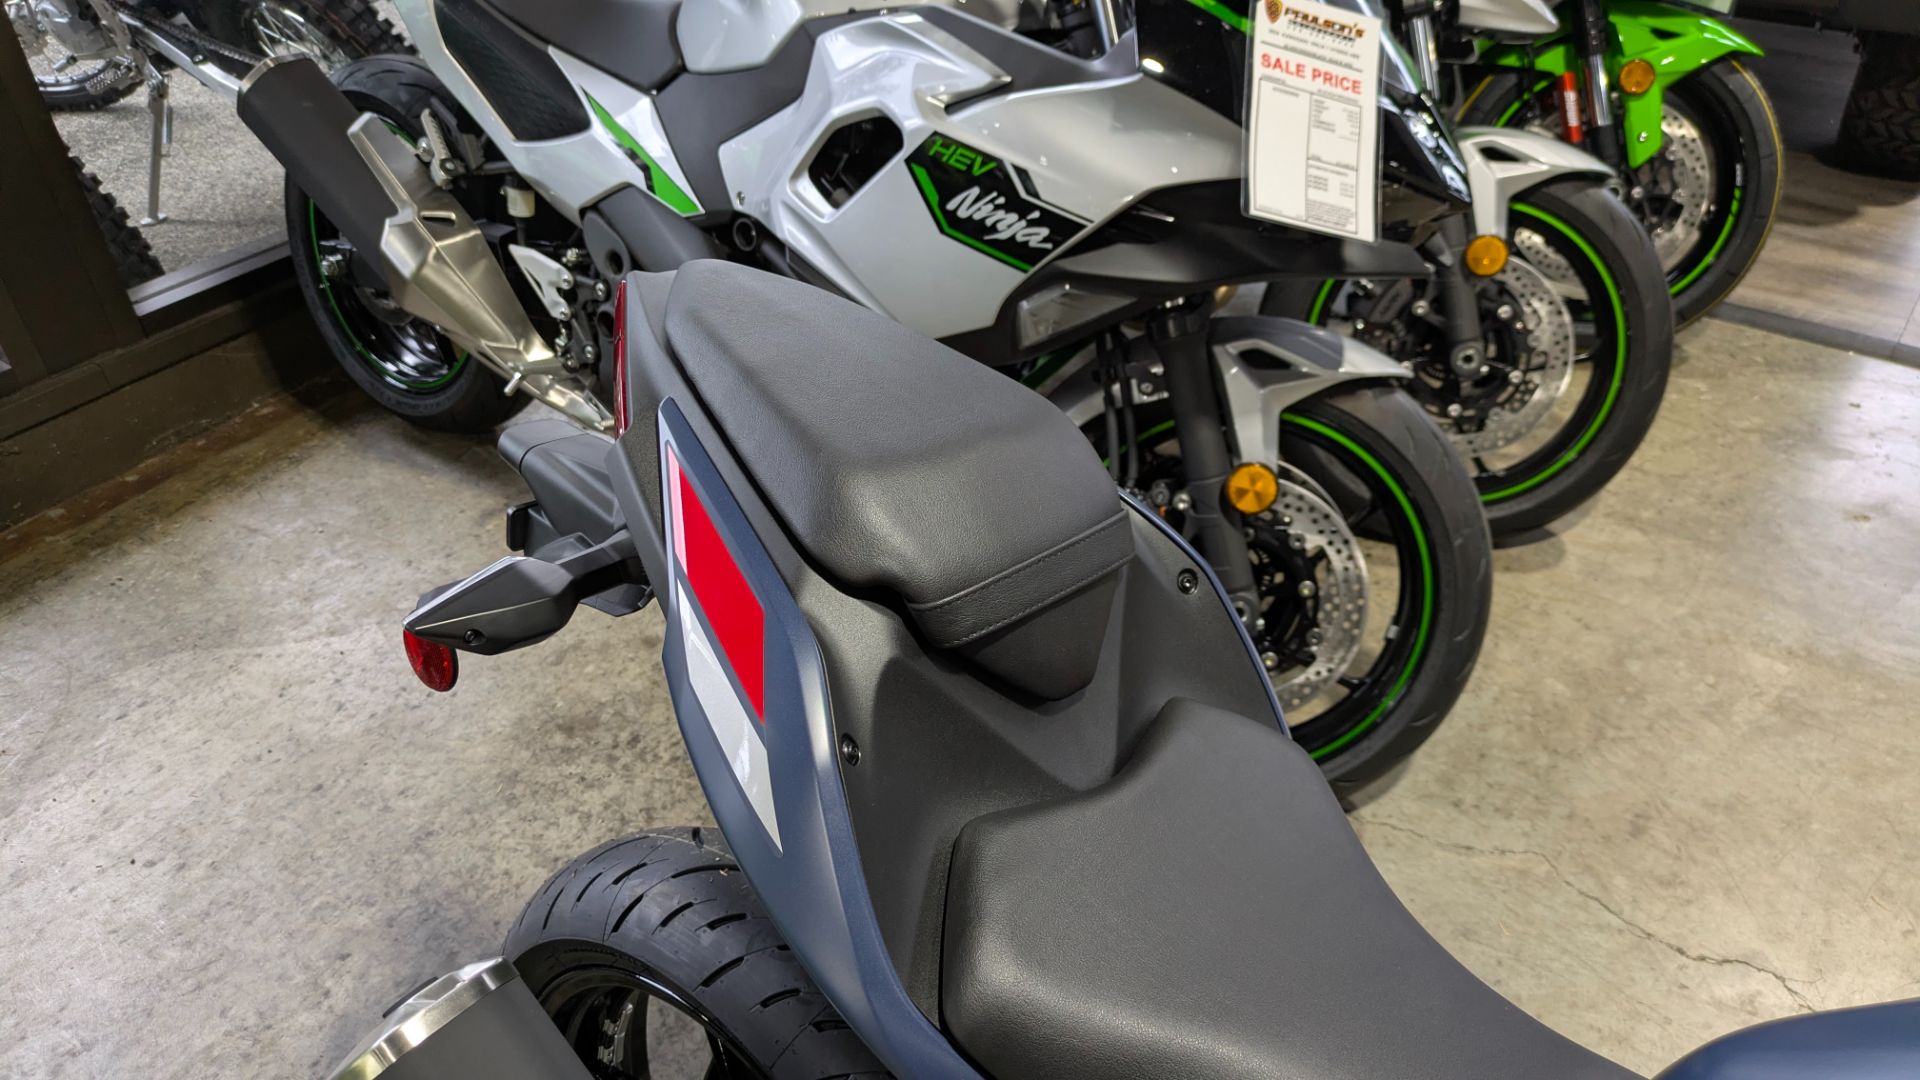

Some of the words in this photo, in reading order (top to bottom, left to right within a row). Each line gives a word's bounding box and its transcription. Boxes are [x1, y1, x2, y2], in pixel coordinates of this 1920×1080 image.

[1260, 53, 1306, 79] SALE
[1311, 68, 1362, 95] PRICE
[928, 138, 998, 176] HEV
[945, 185, 1053, 250] Ninja
